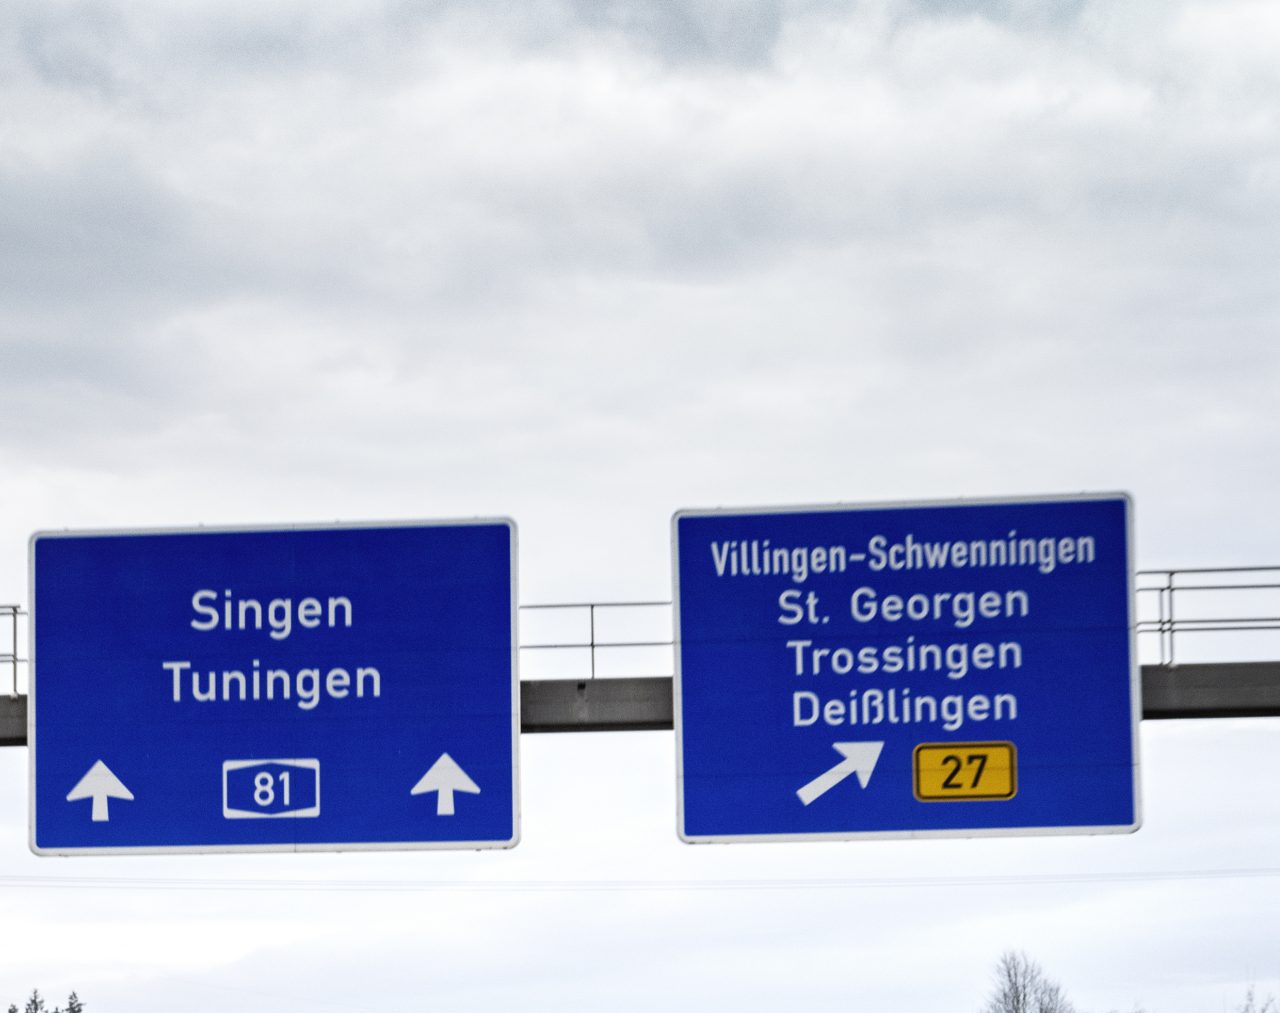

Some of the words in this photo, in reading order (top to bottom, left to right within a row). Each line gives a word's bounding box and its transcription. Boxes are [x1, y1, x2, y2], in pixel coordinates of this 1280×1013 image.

[711, 530, 1095, 583] Villingen-Schwenningen
[190, 589, 353, 640] Singen
[778, 589, 829, 625] St.
[851, 587, 1028, 628] Georgen
[786, 636, 1022, 680] Trossingen
[162, 659, 382, 710] Tuningen
[793, 688, 1017, 731] Deißlingen
[253, 770, 290, 807] 81
[941, 754, 988, 789] 27
